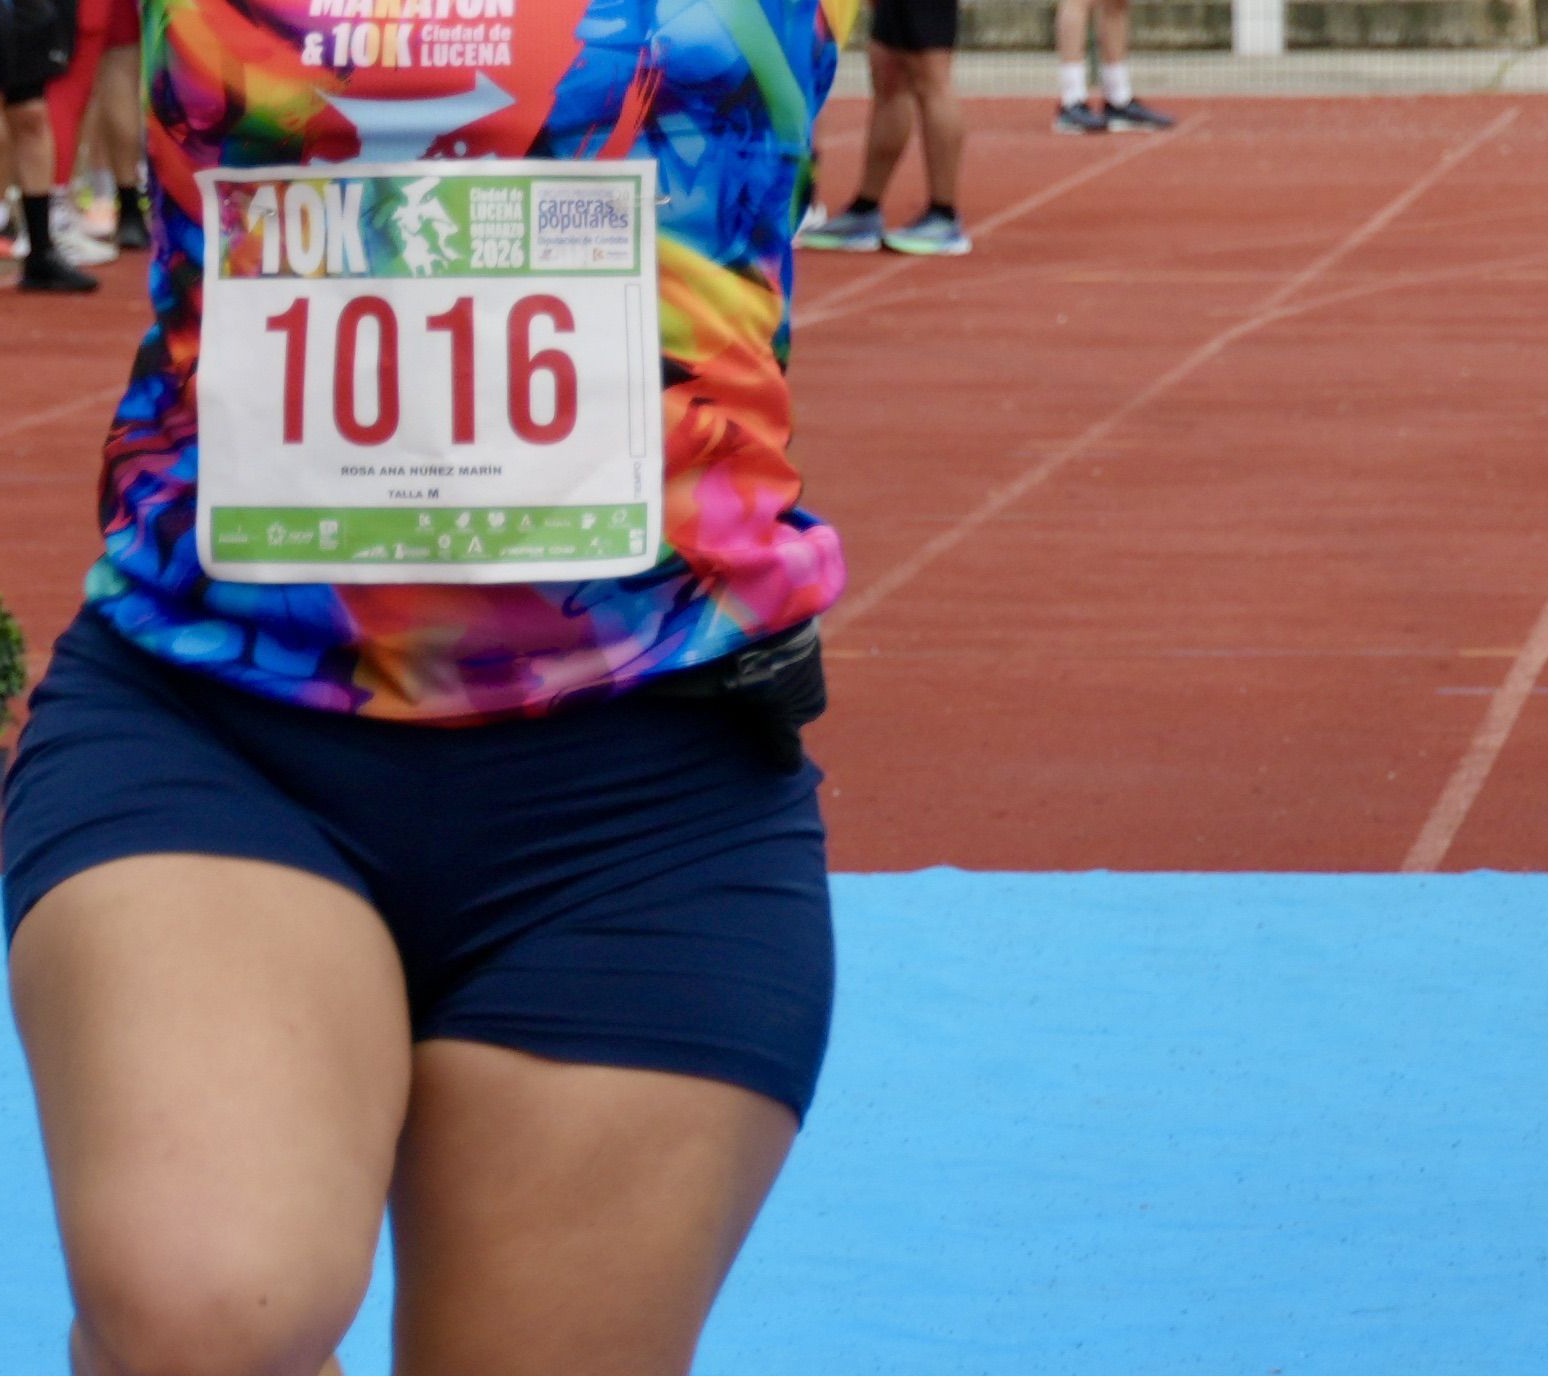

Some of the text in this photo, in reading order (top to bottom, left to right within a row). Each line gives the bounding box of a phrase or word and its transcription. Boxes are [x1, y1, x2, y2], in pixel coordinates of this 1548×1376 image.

[301, 21, 414, 68] & 10K
[420, 23, 513, 42] Ciudad de
[420, 43, 513, 67] LUCENA
[538, 198, 615, 217] carreras
[248, 182, 370, 276] 10K
[538, 209, 629, 234] populares
[471, 238, 525, 269] 2026
[266, 294, 578, 446] 1016
[340, 465, 375, 477] ROSA
[379, 465, 406, 477] ANA
[388, 488, 440, 499] TALLA M
